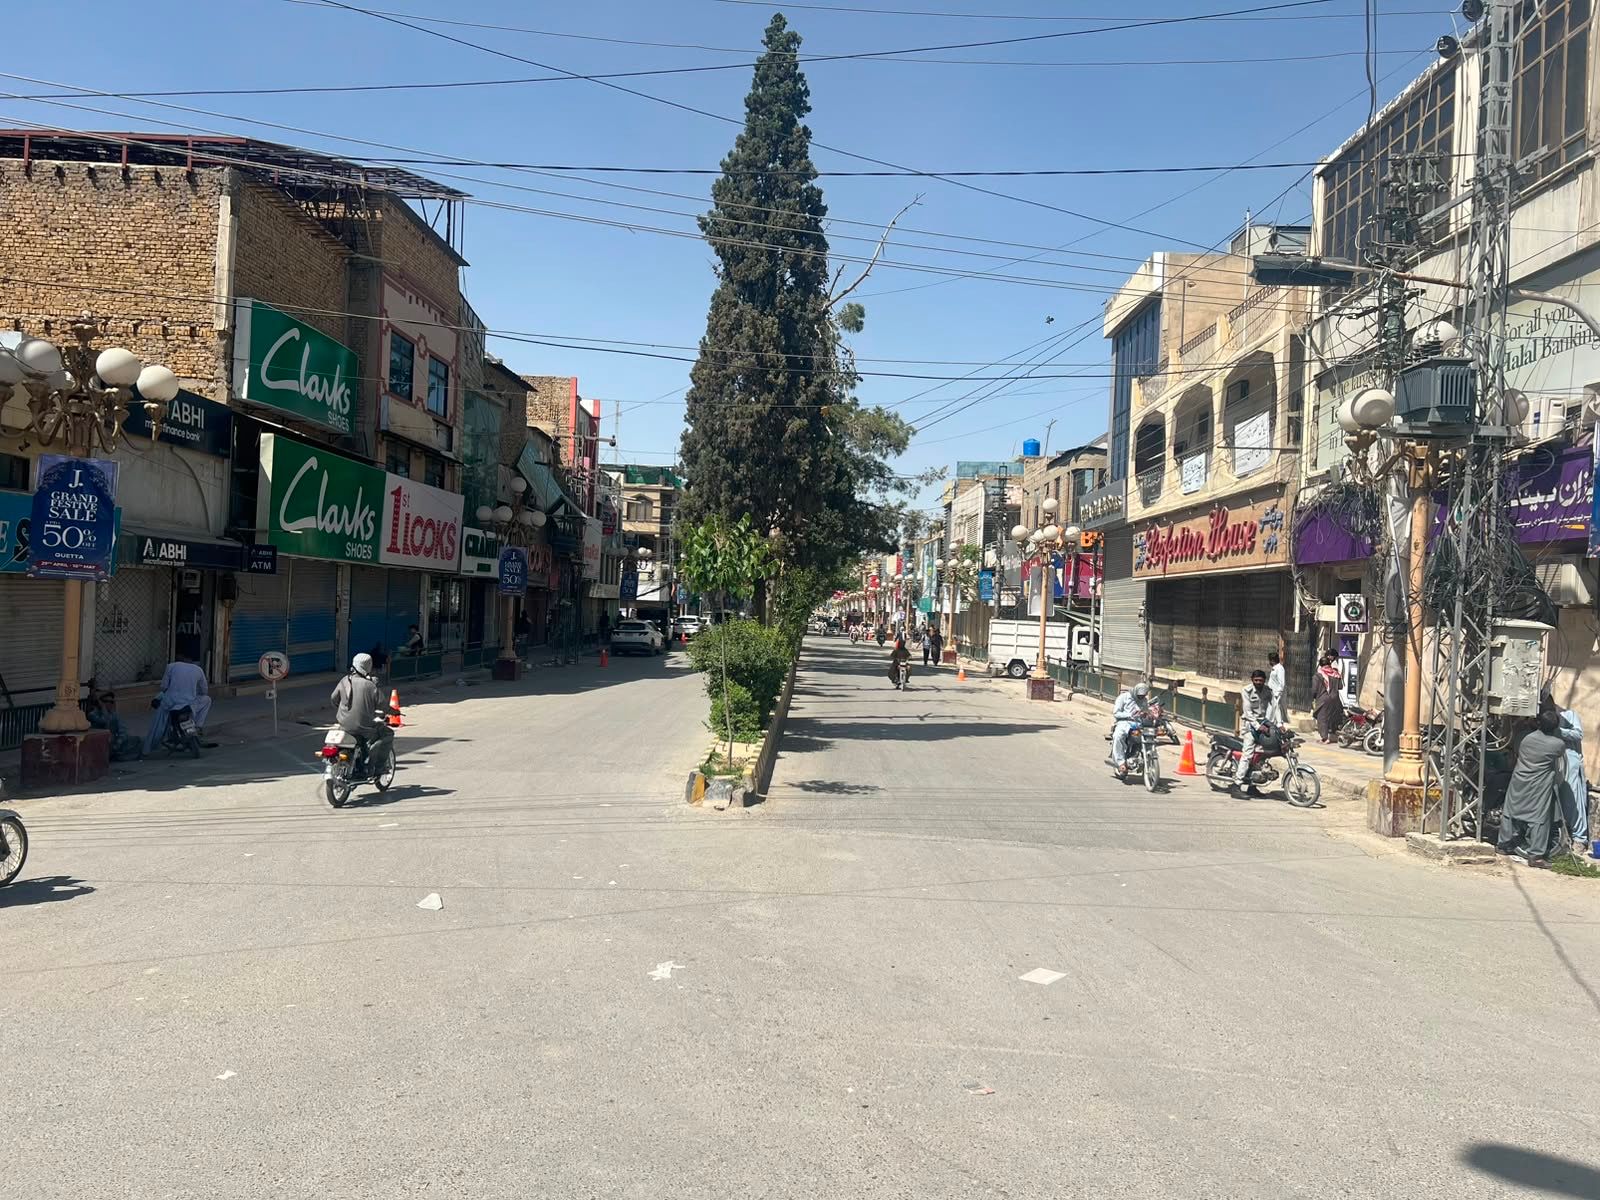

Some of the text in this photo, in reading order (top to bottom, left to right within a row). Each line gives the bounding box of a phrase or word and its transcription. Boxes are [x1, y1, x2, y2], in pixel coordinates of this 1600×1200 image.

[1526, 308, 1541, 335] all
[1545, 306, 1575, 336] you
[1541, 324, 1600, 360] Banking
[260, 327, 351, 416] Clarks
[171, 400, 204, 430] ABHI
[327, 410, 351, 432] SHOES
[186, 428, 201, 442] bank
[51, 491, 98, 503] GRAND
[51, 499, 97, 511] FESTIVE
[279, 455, 376, 542] Clarks
[49, 507, 97, 522] SALE
[42, 523, 97, 549] 50%
[1145, 521, 1205, 572] Perfection
[1207, 506, 1257, 560] House
[55, 552, 84, 560] QUETTA
[160, 542, 187, 560] ABHI
[345, 541, 373, 561] SHOES
[251, 561, 272, 570] ATM
